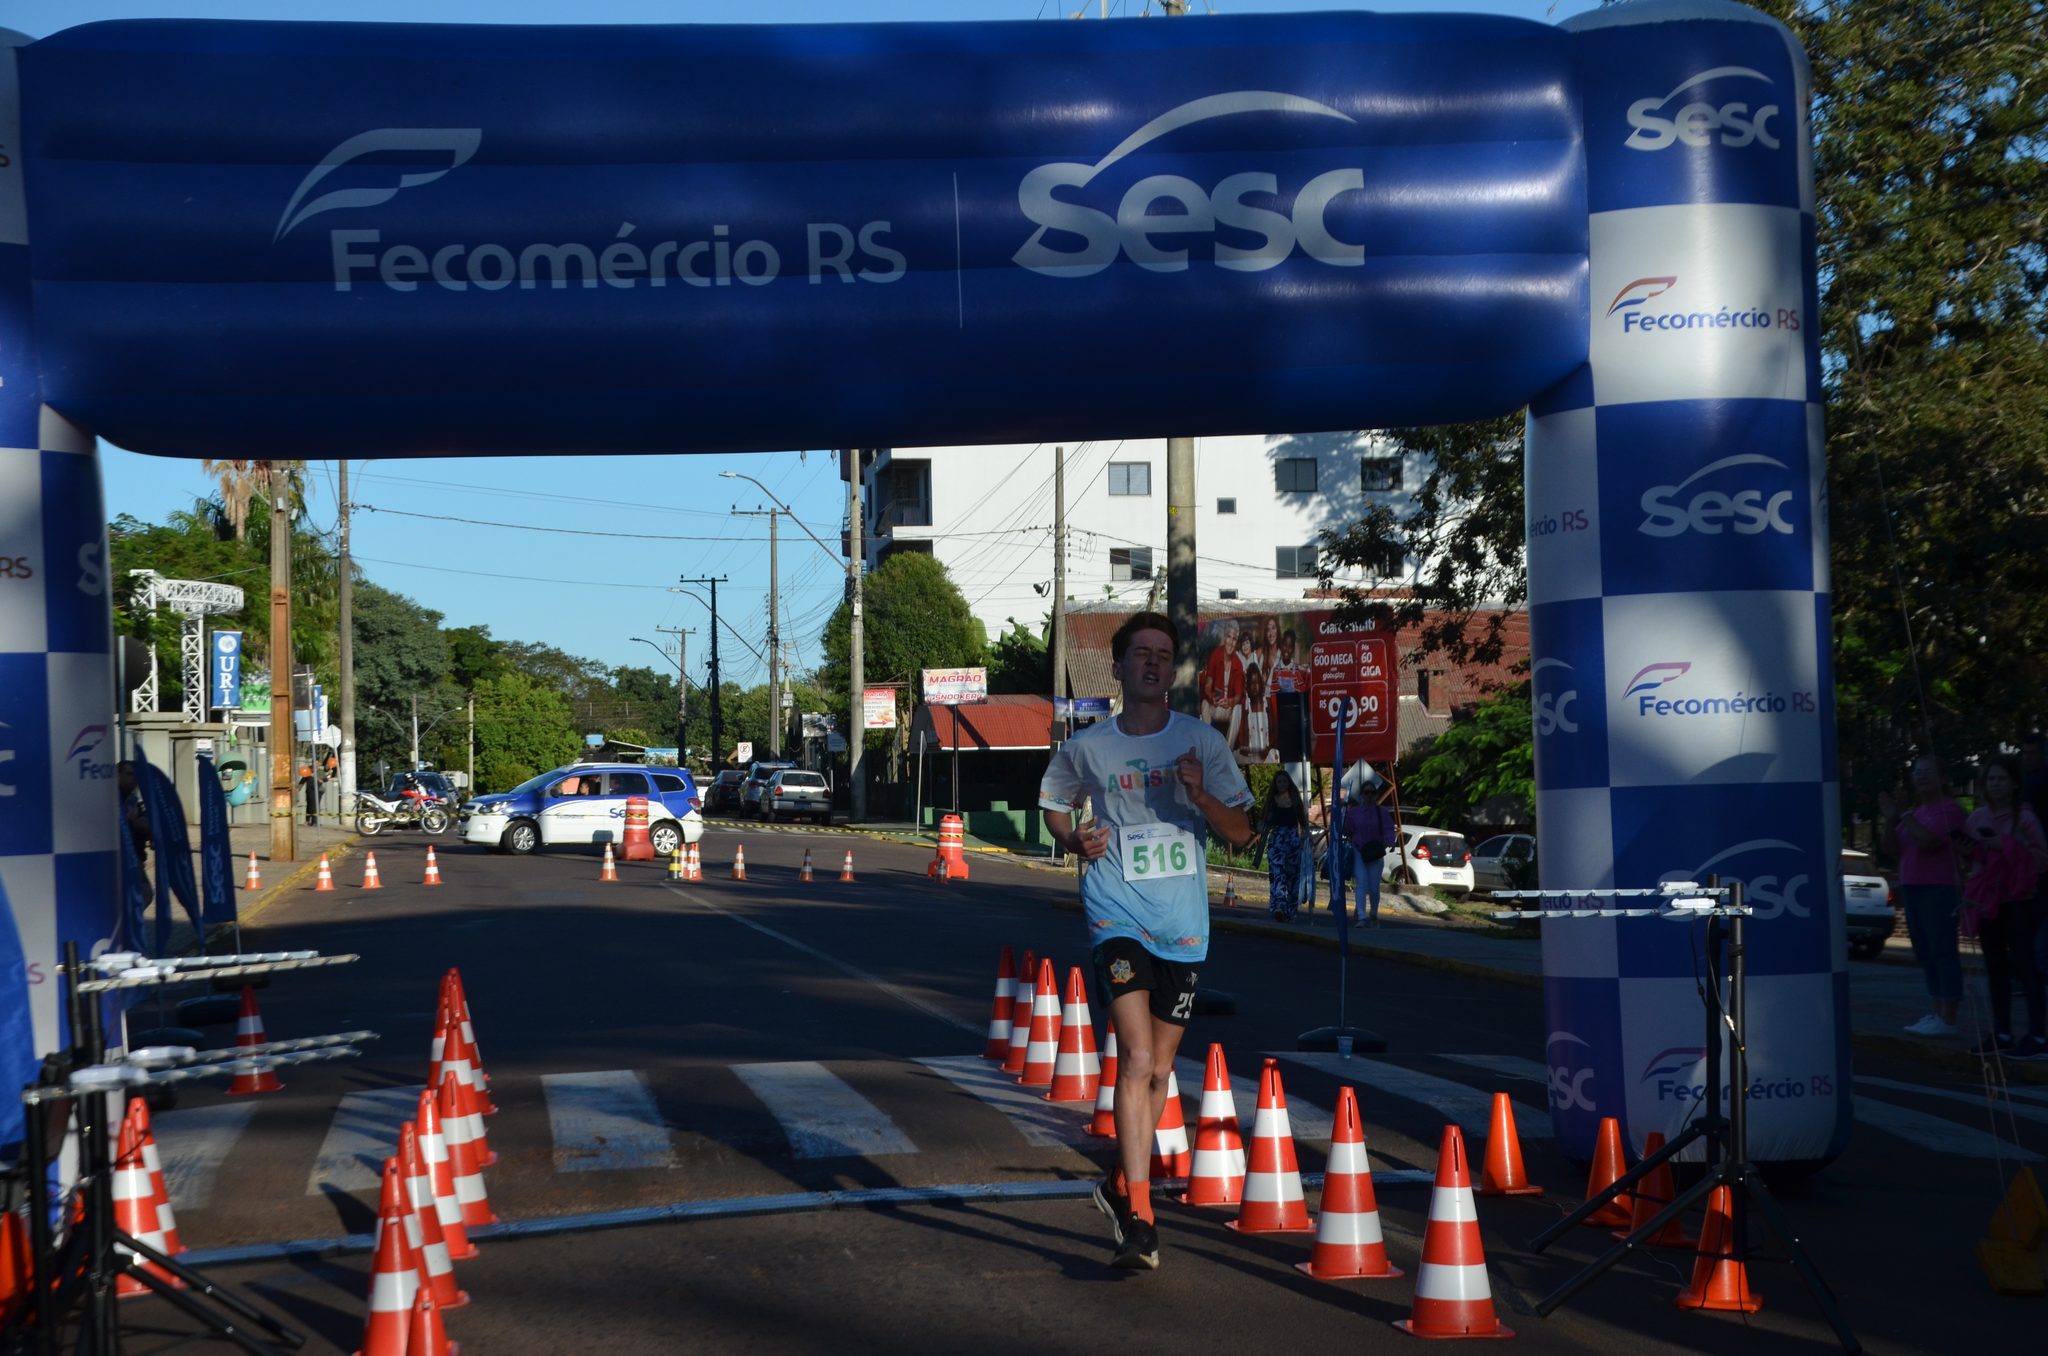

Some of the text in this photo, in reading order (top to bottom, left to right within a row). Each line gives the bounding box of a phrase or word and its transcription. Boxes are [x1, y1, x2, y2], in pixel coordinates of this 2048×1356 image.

[330, 220, 908, 293] Fecomércio RS
[1624, 305, 1801, 332] Fecomércio RS
[1562, 509, 1590, 532] RS
[1314, 653, 1354, 666] 600 MEGA
[1361, 652, 1372, 663] 60
[219, 656, 235, 705] URI
[1361, 665, 1381, 677] GIGA
[1319, 699, 1327, 709] R$
[1639, 691, 1816, 716] Fecomércio RS
[609, 808, 626, 818] Se
[1133, 842, 1187, 874] 516
[1657, 1075, 1833, 1102] Fecércio RS
